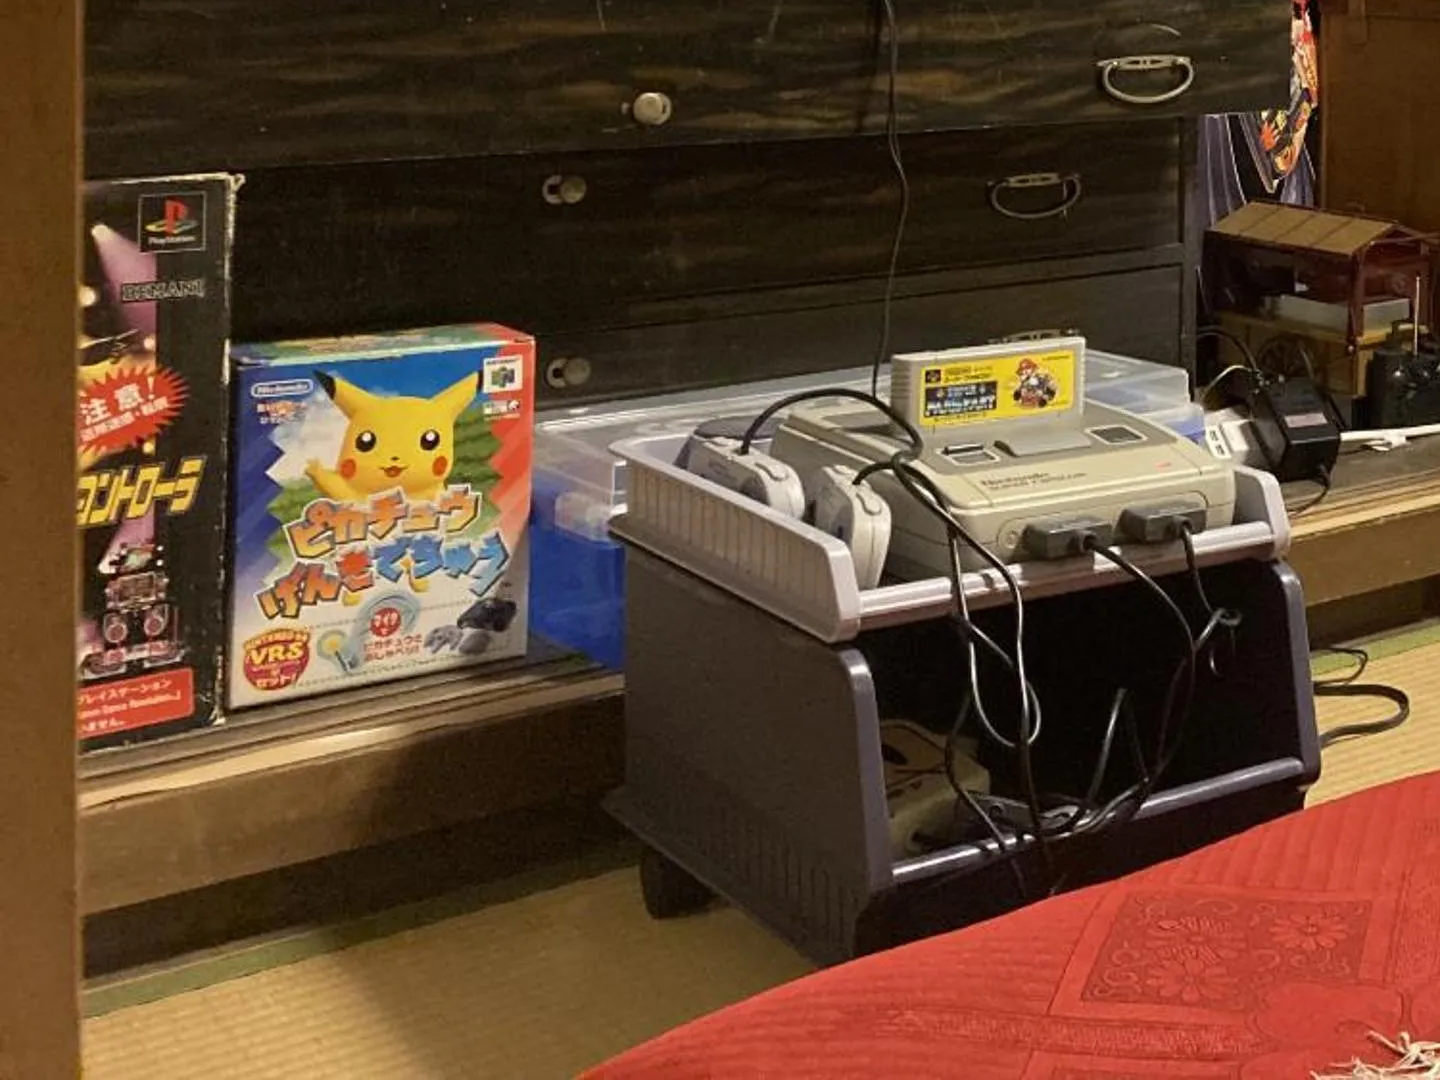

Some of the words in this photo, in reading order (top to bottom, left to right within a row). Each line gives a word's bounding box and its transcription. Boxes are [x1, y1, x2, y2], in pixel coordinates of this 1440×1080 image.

[288, 486, 481, 559] ピカチュウ
